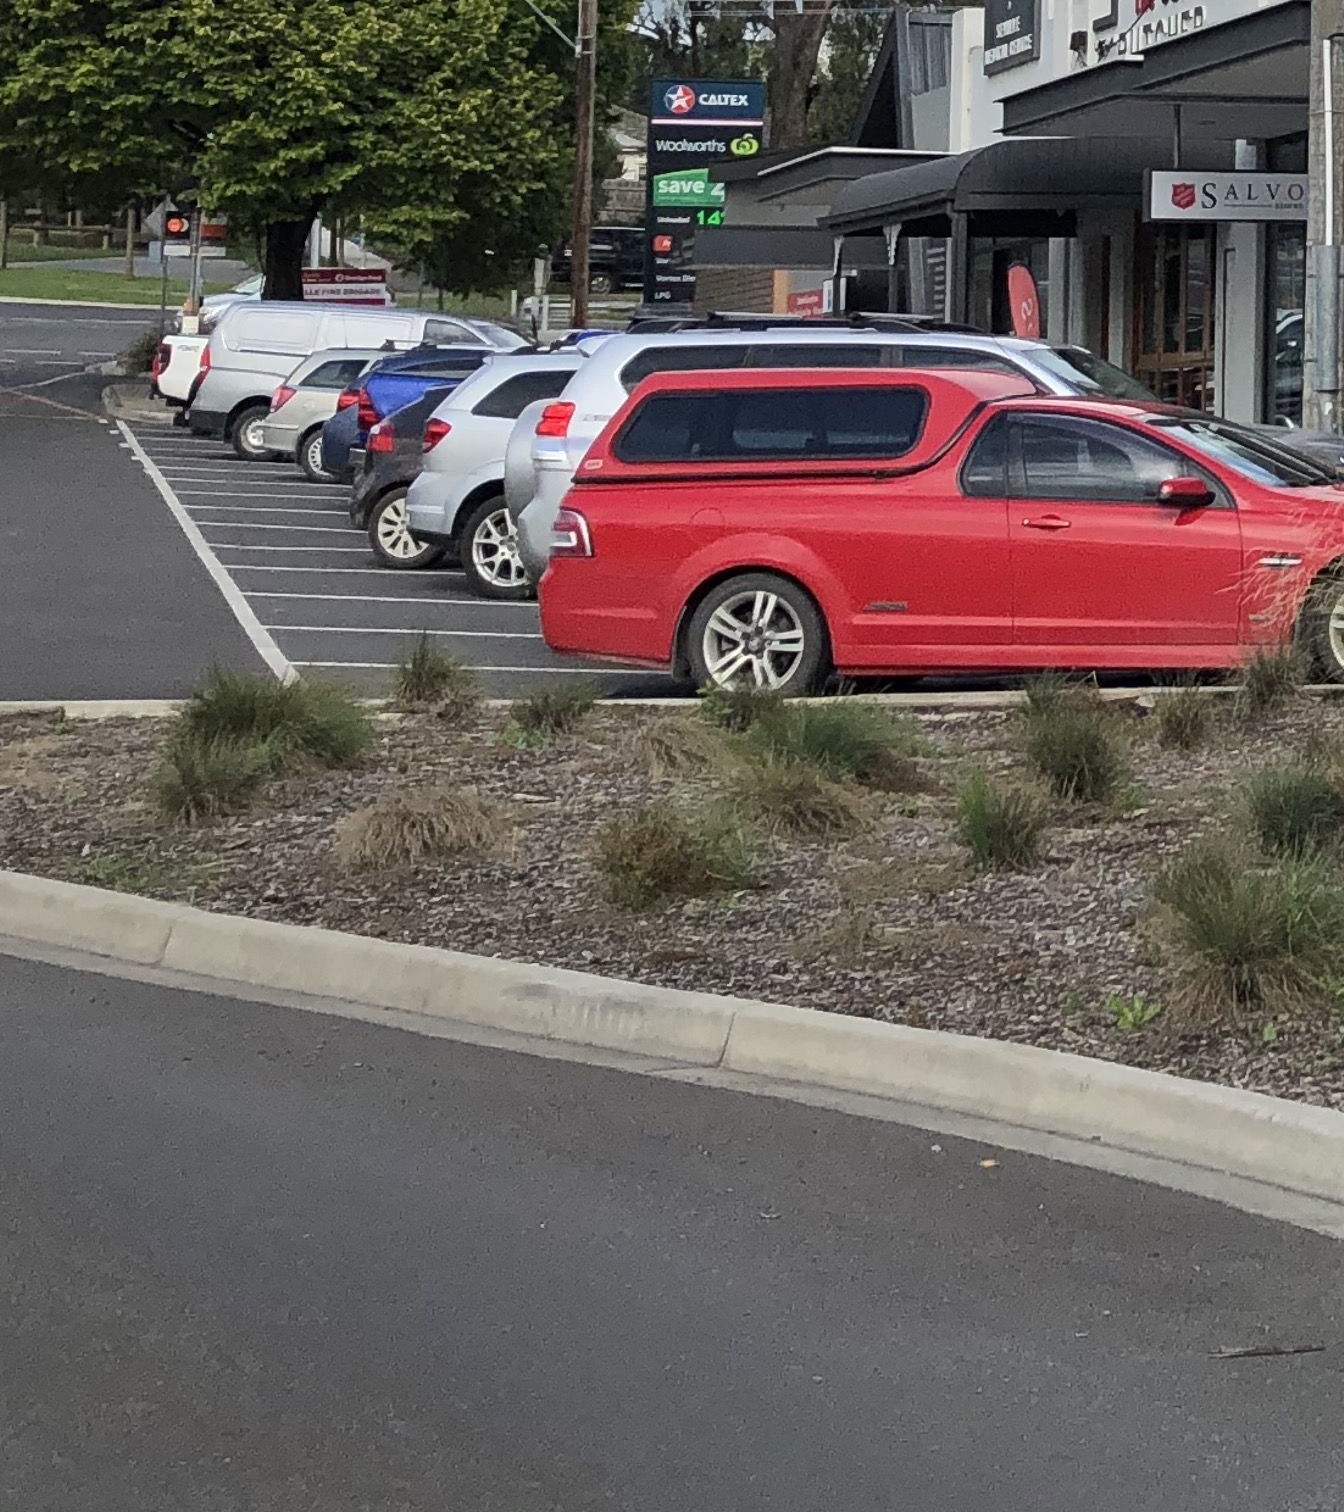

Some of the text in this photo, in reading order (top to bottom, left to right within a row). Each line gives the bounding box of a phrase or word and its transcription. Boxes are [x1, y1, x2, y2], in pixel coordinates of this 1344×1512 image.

[698, 93, 749, 106] CALTEX
[655, 139, 726, 152] Woolworths
[658, 179, 705, 194] save
[1201, 182, 1305, 209] SALVO
